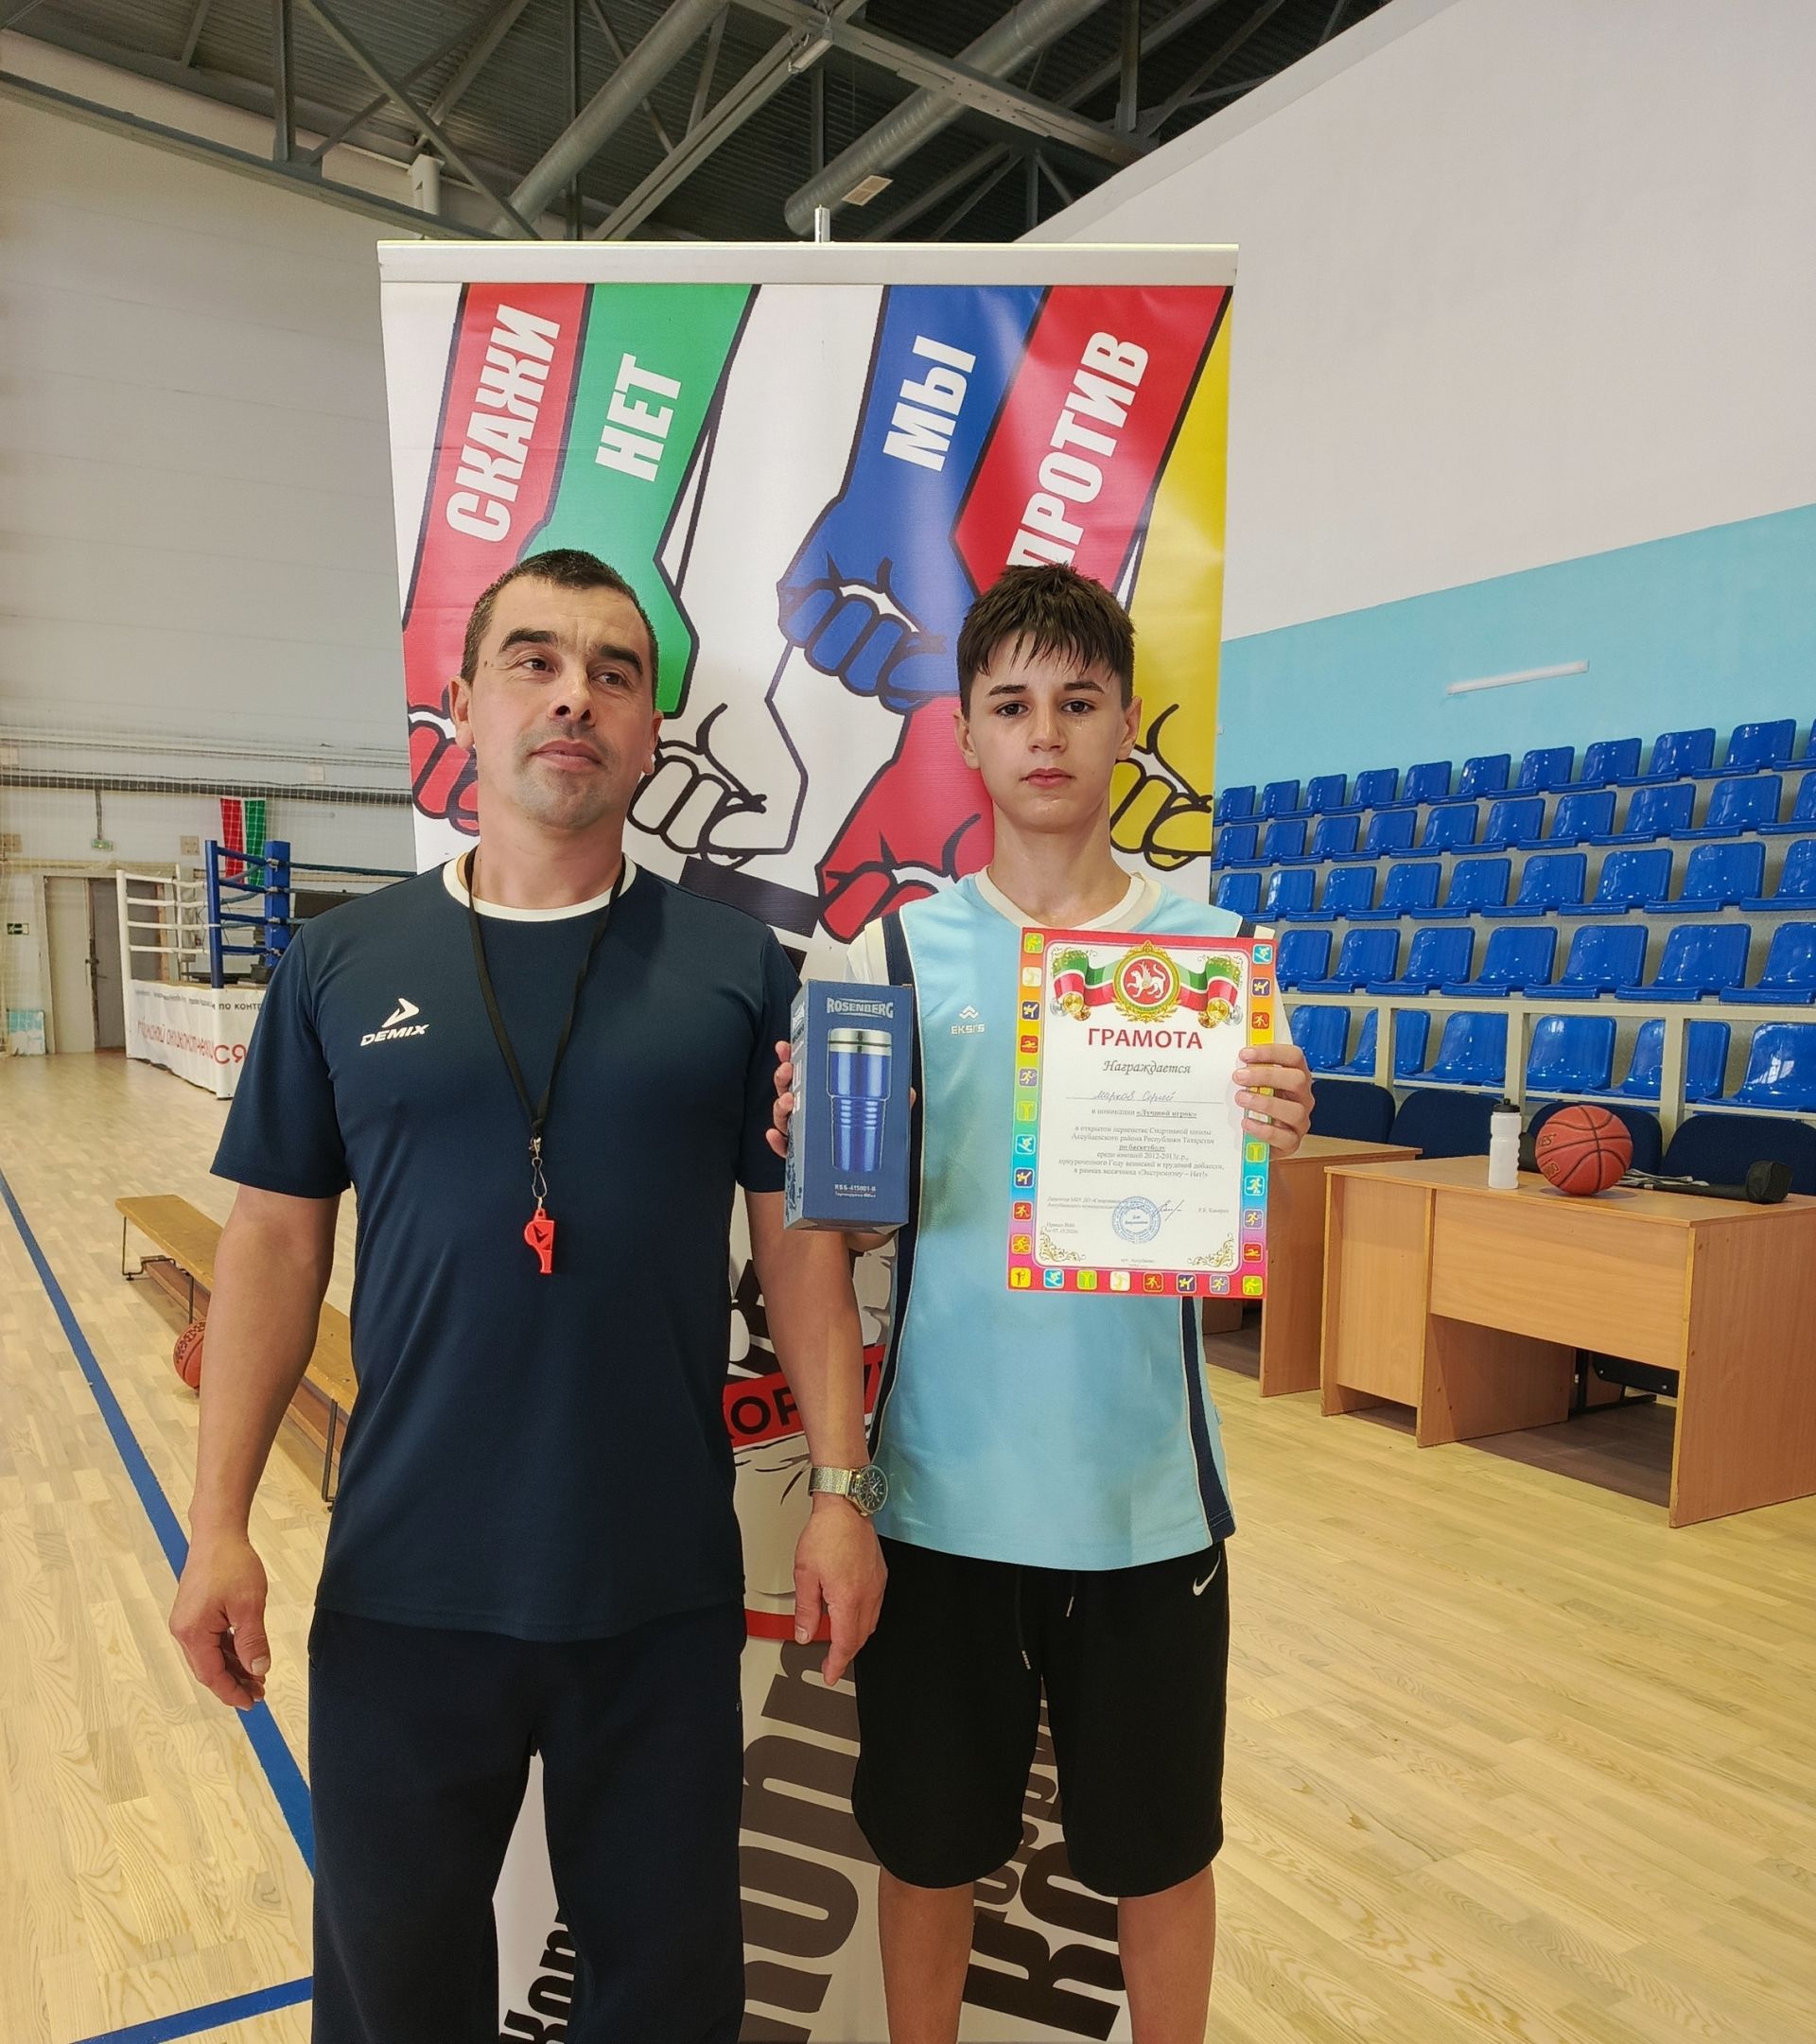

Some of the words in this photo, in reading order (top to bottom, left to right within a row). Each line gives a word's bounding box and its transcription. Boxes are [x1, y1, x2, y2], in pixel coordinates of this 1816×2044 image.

[445, 304, 561, 543] СКАЖИ
[595, 352, 682, 482] НЕТ
[882, 335, 977, 472] МЫ
[1005, 331, 1149, 566] ПРОТИВ
[360, 1023, 429, 1047] DEMIX
[826, 997, 894, 1019] ROSENBERG
[1088, 1028, 1203, 1050] ГРАМОТА
[1103, 1060, 1191, 1075] Награждается
